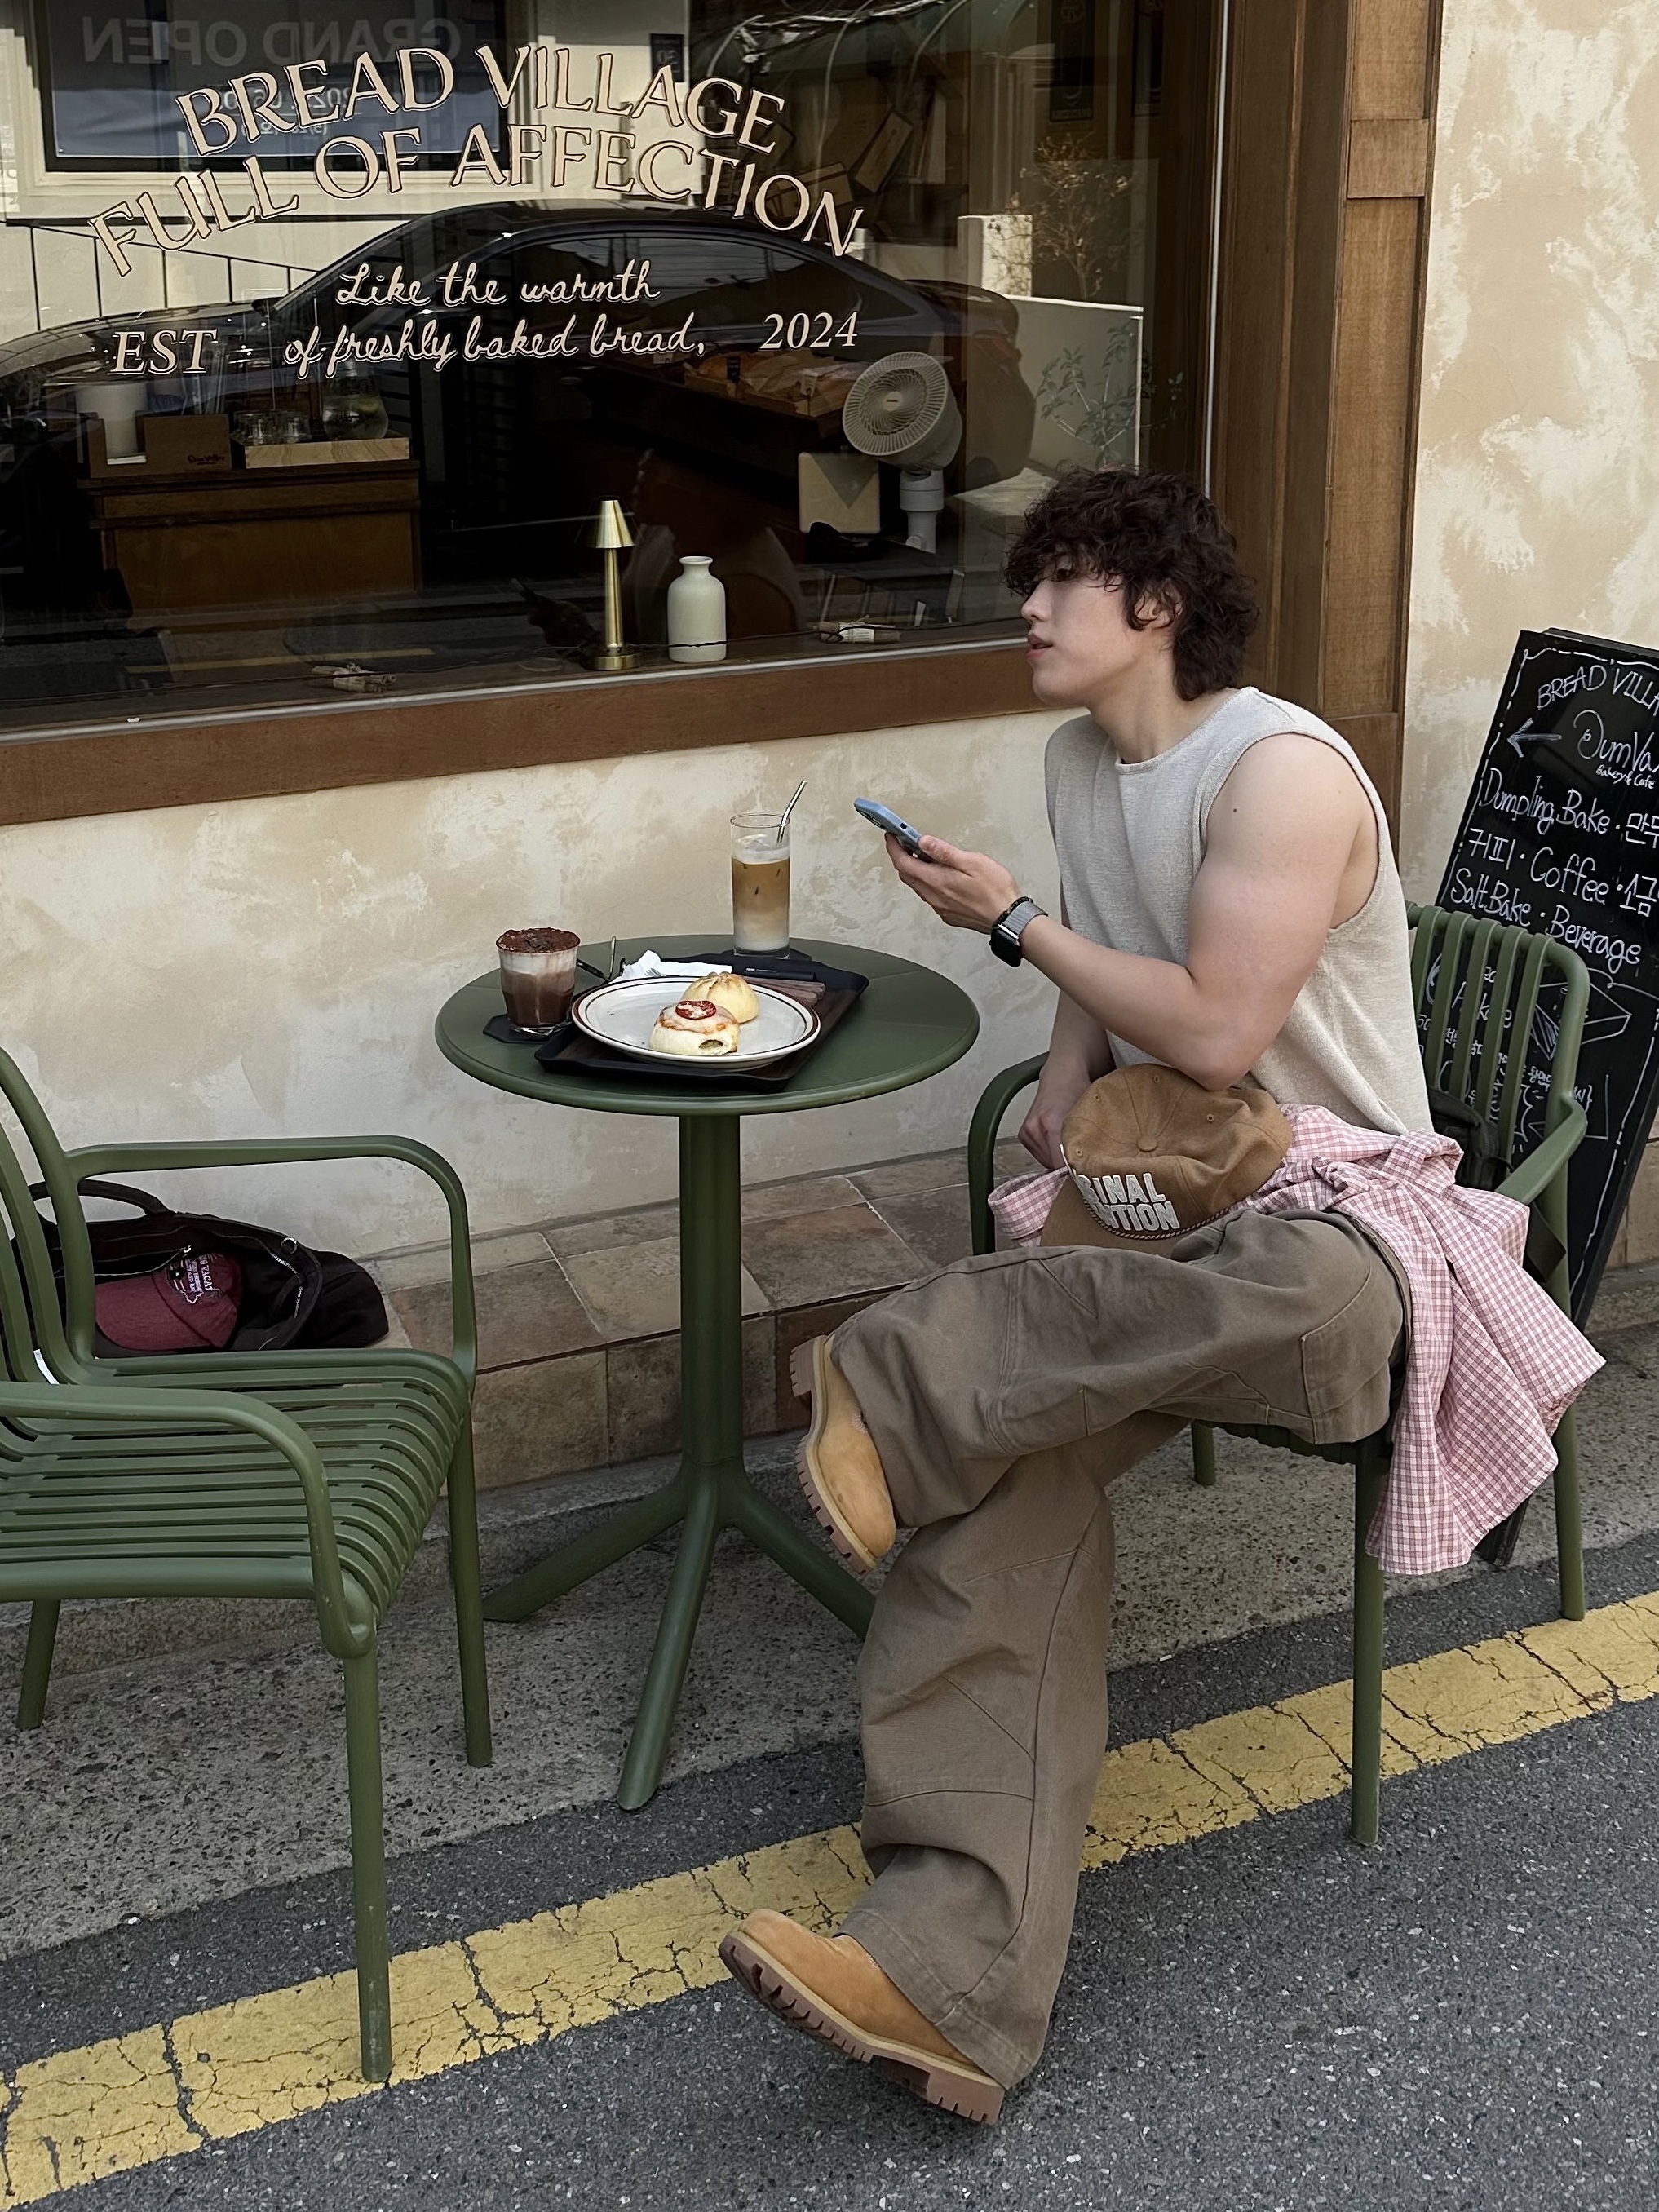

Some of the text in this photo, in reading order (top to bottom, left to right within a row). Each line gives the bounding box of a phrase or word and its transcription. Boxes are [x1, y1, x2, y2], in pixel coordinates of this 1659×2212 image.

[176, 45, 785, 156] BREAD VILLAGE
[89, 155, 299, 276] FULL
[313, 127, 421, 199] OF
[450, 122, 865, 257] AFFECTION
[335, 259, 661, 307] Like the warmth
[107, 329, 218, 375] EST
[284, 312, 705, 379] of freshly baked bread,
[759, 312, 857, 349] 2024
[1537, 665, 1607, 710] BREAD
[1479, 768, 1555, 835] Dumpling
[1555, 788, 1611, 834] Bake
[1530, 847, 1610, 905] Coffee
[1545, 904, 1642, 975] Beverage
